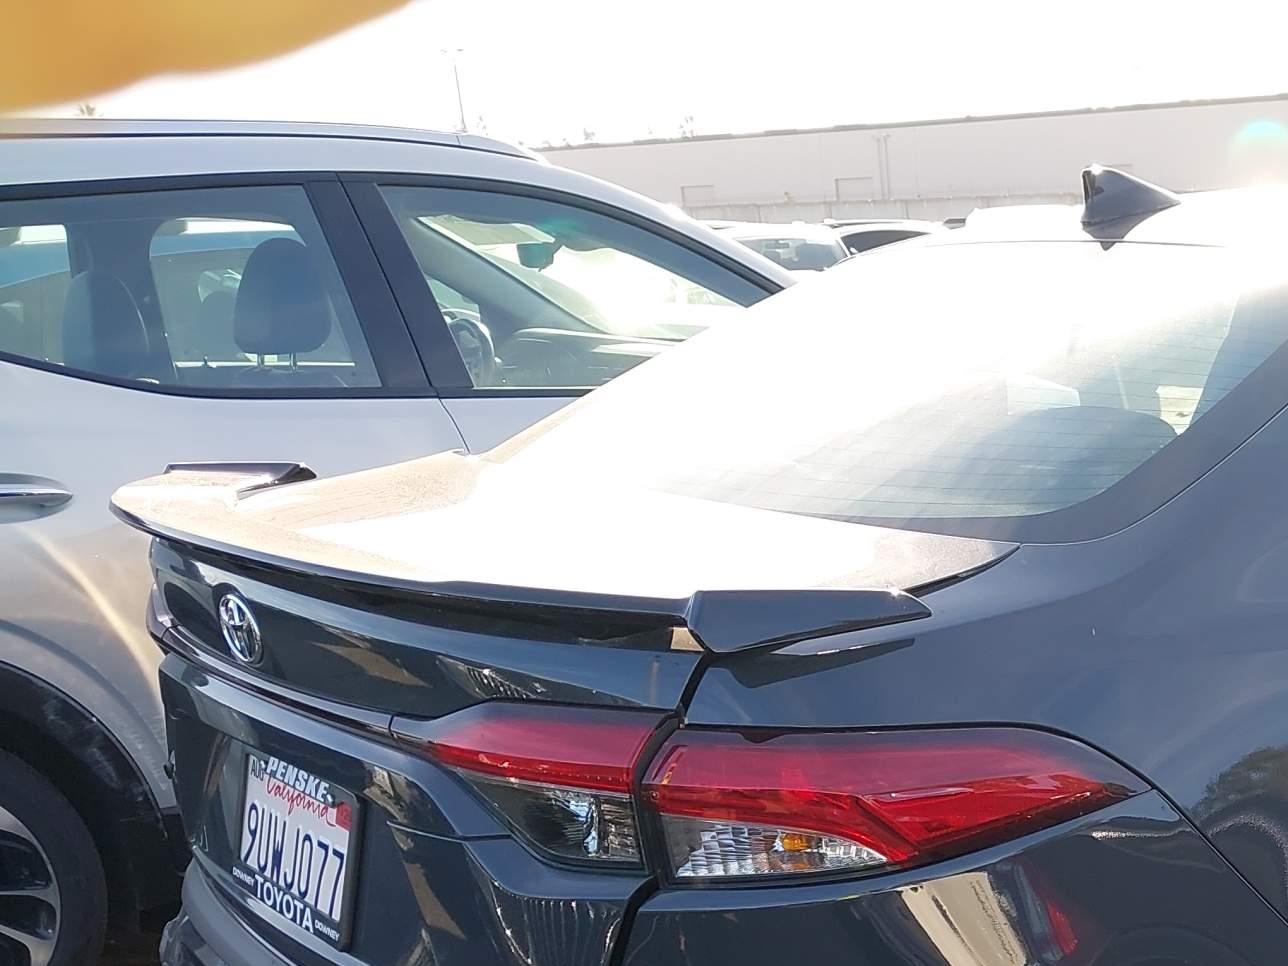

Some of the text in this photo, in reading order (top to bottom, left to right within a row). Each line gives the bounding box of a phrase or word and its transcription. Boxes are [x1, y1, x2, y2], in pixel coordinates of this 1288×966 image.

[266, 756, 330, 803] PENSKE
[243, 802, 345, 919] 9UWJ077
[232, 866, 340, 941] DOWNEY TOYOTA DOWNEY
